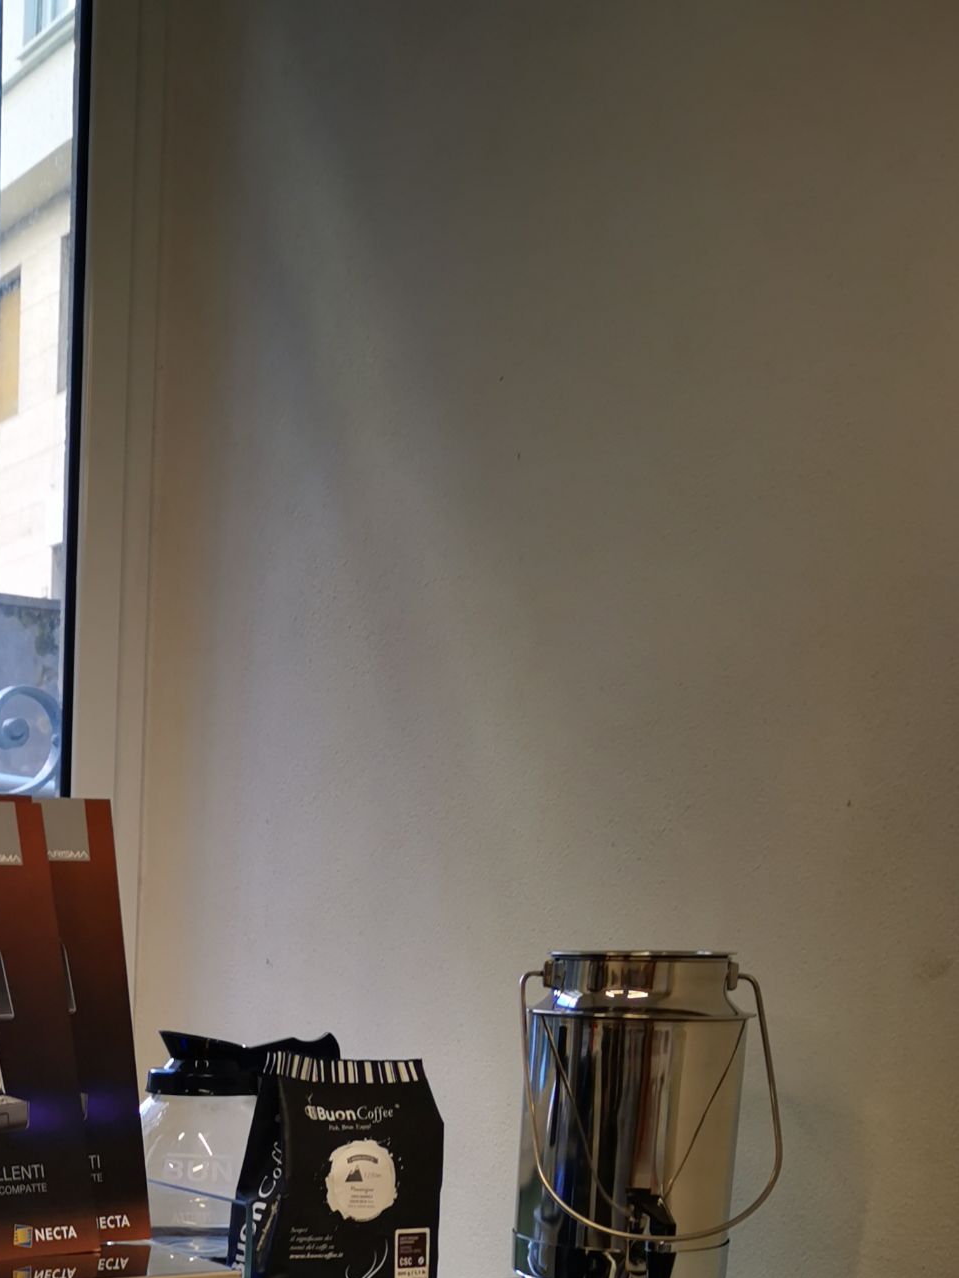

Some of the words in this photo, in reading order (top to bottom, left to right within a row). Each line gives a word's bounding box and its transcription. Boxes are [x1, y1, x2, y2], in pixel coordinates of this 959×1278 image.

[88, 1154, 101, 1170] TI
[96, 1214, 131, 1230] ECTA
[34, 1225, 78, 1241] NECTA
